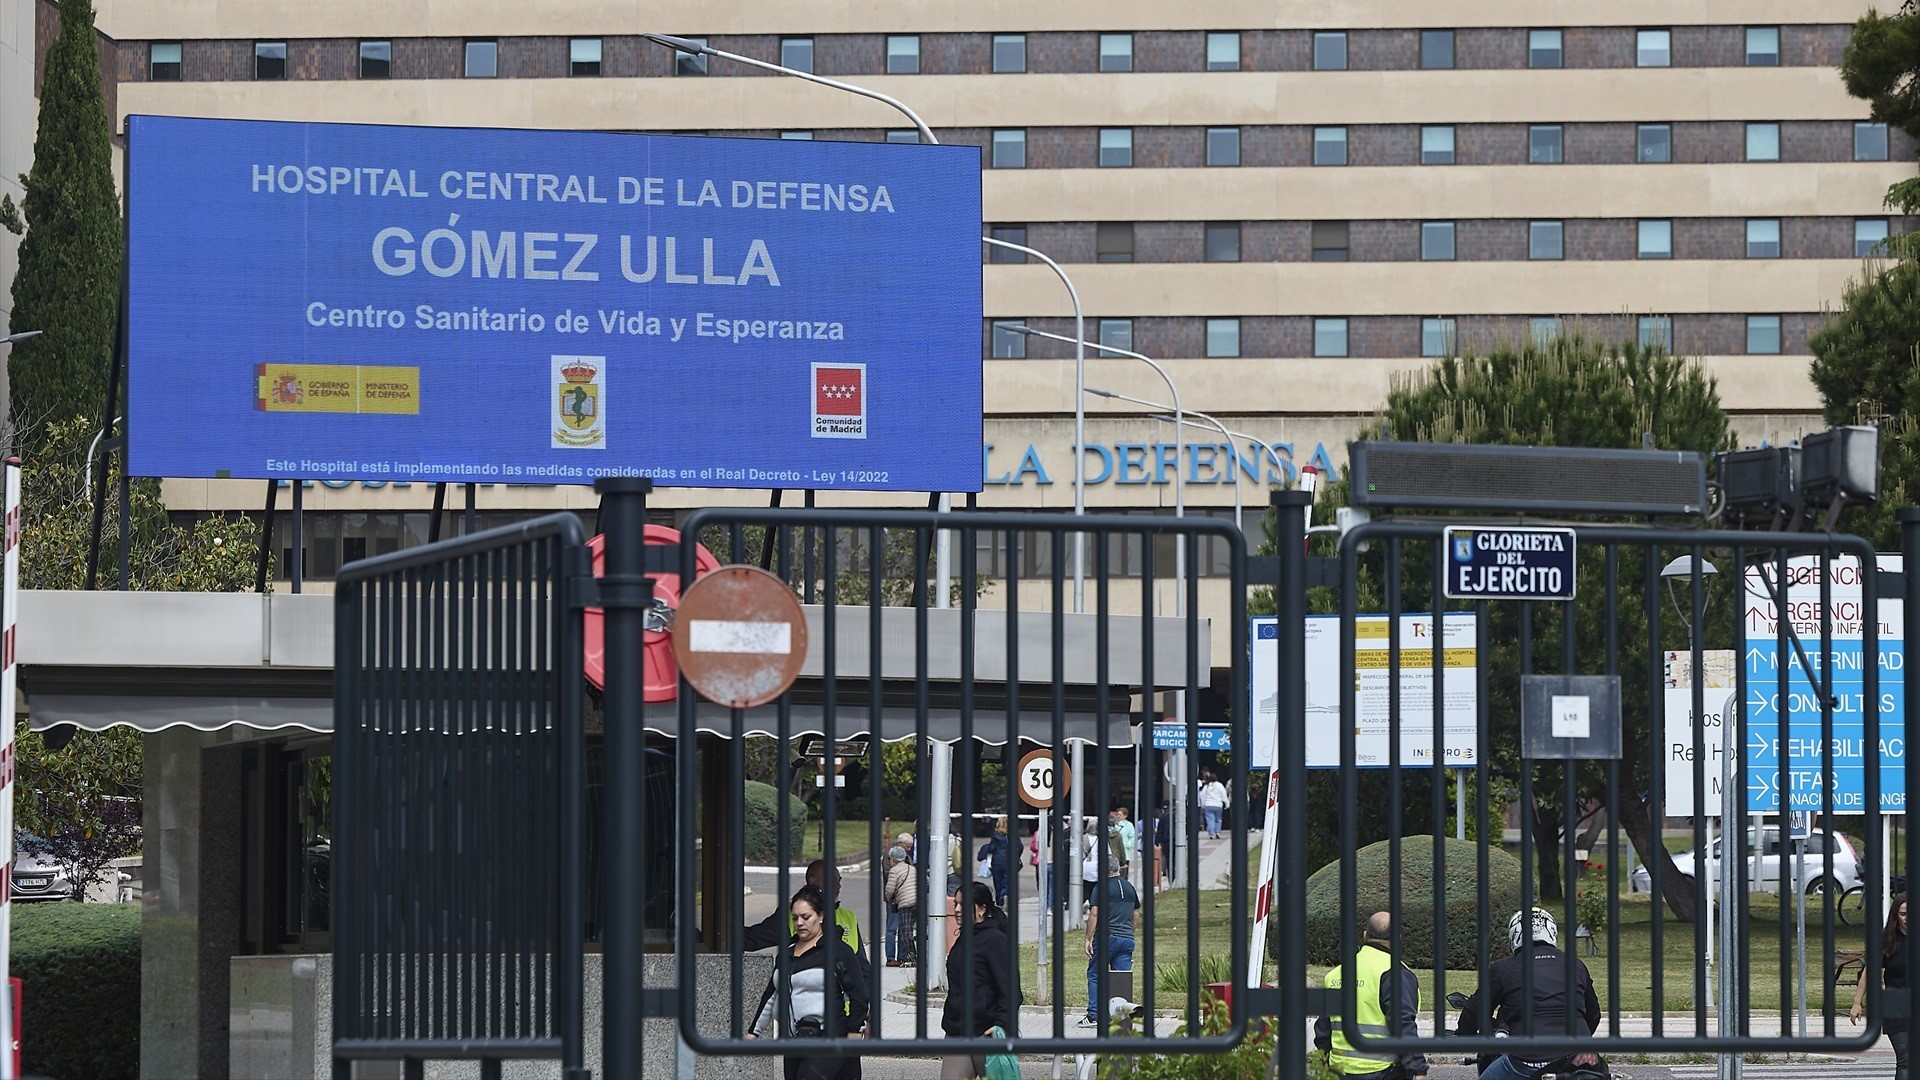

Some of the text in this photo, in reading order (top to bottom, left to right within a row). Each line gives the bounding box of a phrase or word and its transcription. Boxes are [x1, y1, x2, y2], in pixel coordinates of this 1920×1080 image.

[251, 163, 895, 214] HOSPITAL CENTRAL DE LA DEFENSA
[371, 212, 781, 287] GÓMEZ ULLA
[306, 301, 844, 343] Centro Sanitario de Vida y Esperanza
[308, 381, 351, 390] GOBIERNO
[308, 388, 350, 397] DE ESPAÑA
[365, 383, 409, 391] MINISTERIO
[365, 390, 411, 399] DE DEFENSA
[815, 417, 862, 425] Comunidad
[815, 425, 862, 433] de Madrid
[266, 459, 297, 472] Este
[300, 460, 358, 474] Hospital
[360, 461, 391, 474] está
[393, 462, 499, 477] implementando
[502, 464, 522, 476] las
[526, 464, 583, 477] medidas
[586, 466, 676, 479] consideradas
[680, 470, 696, 479] en
[700, 467, 712, 479] el
[715, 467, 745, 480] Real
[749, 468, 800, 481] Decreto
[812, 470, 836, 483] Ley
[839, 470, 889, 483] 14/2022
[982, 442, 1337, 485] LA DEFENSA
[1476, 532, 1564, 552] GLORIETA
[1496, 552, 1526, 566] DEL
[1458, 565, 1562, 593] EJERCITO
[1767, 566, 1886, 586] URGENCI
[1767, 602, 1866, 621] URGENCI
[1836, 622, 1894, 634] INFATIL
[1672, 743, 1706, 761] Re
[1029, 768, 1055, 789] 30
[1771, 792, 1841, 806] DNACIN
[1844, 793, 1863, 805] DE
